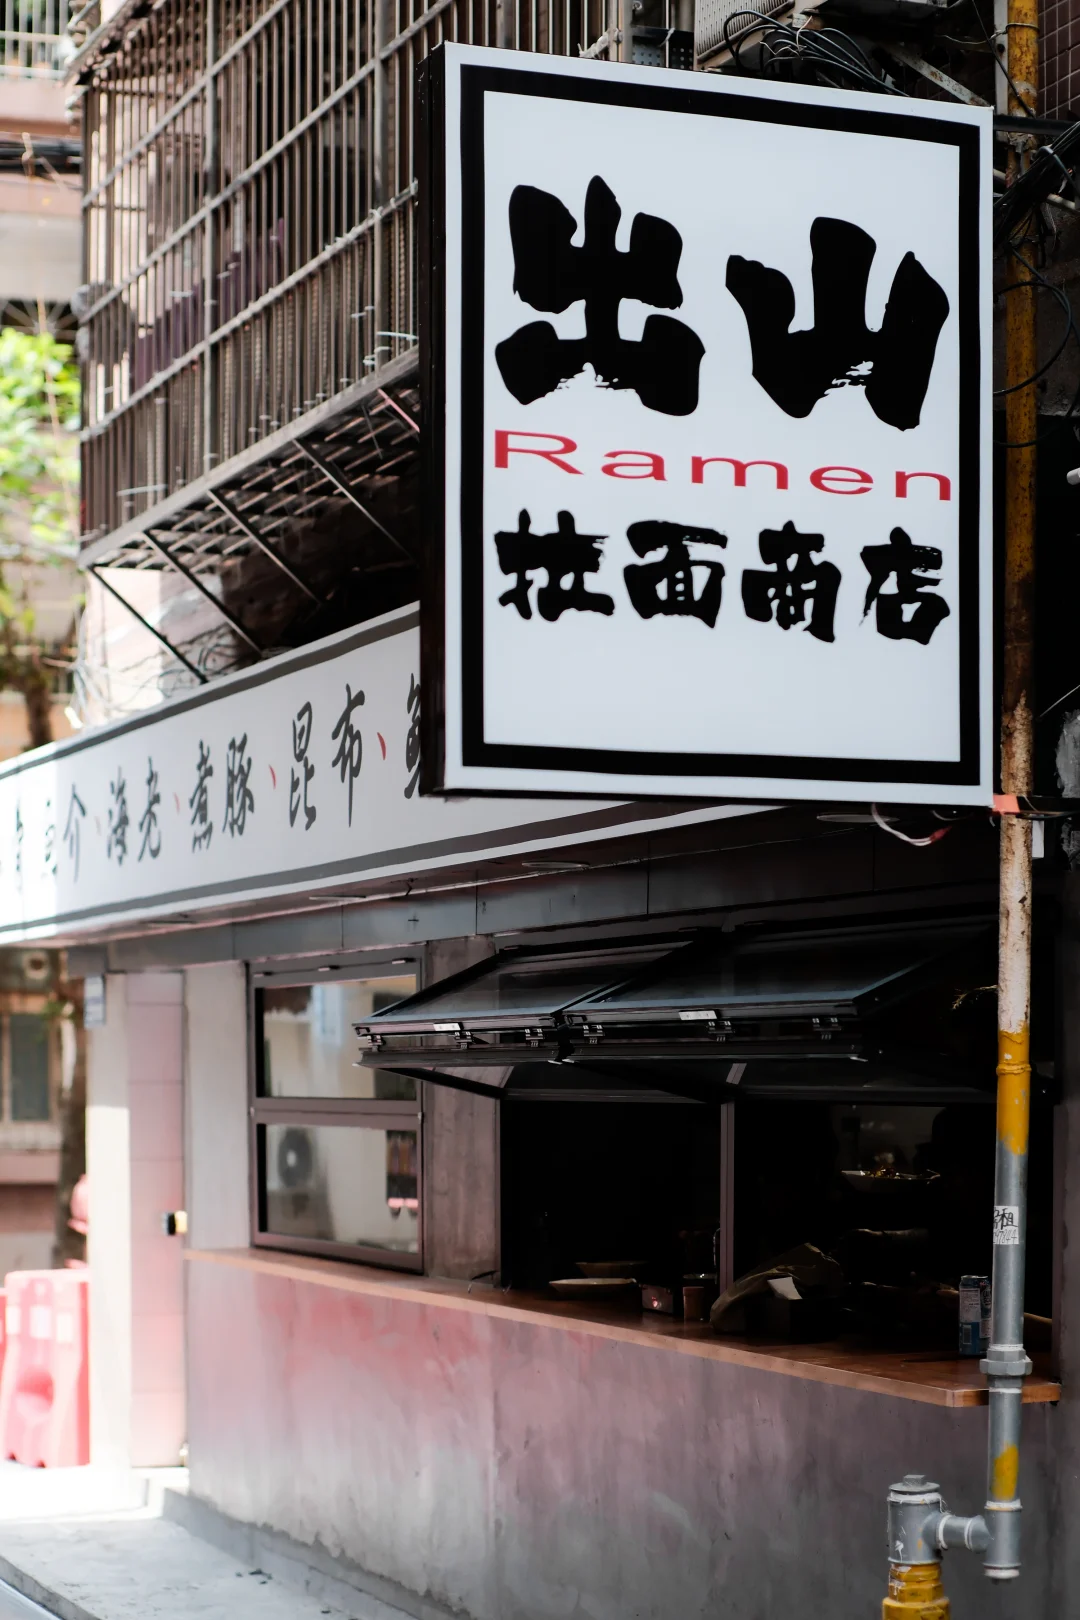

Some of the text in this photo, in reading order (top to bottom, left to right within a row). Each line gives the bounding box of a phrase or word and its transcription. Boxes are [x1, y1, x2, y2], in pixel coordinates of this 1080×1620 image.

[495, 175, 949, 431] 出山
[495, 429, 951, 501] Ramen
[495, 508, 951, 646] 拉面商店
